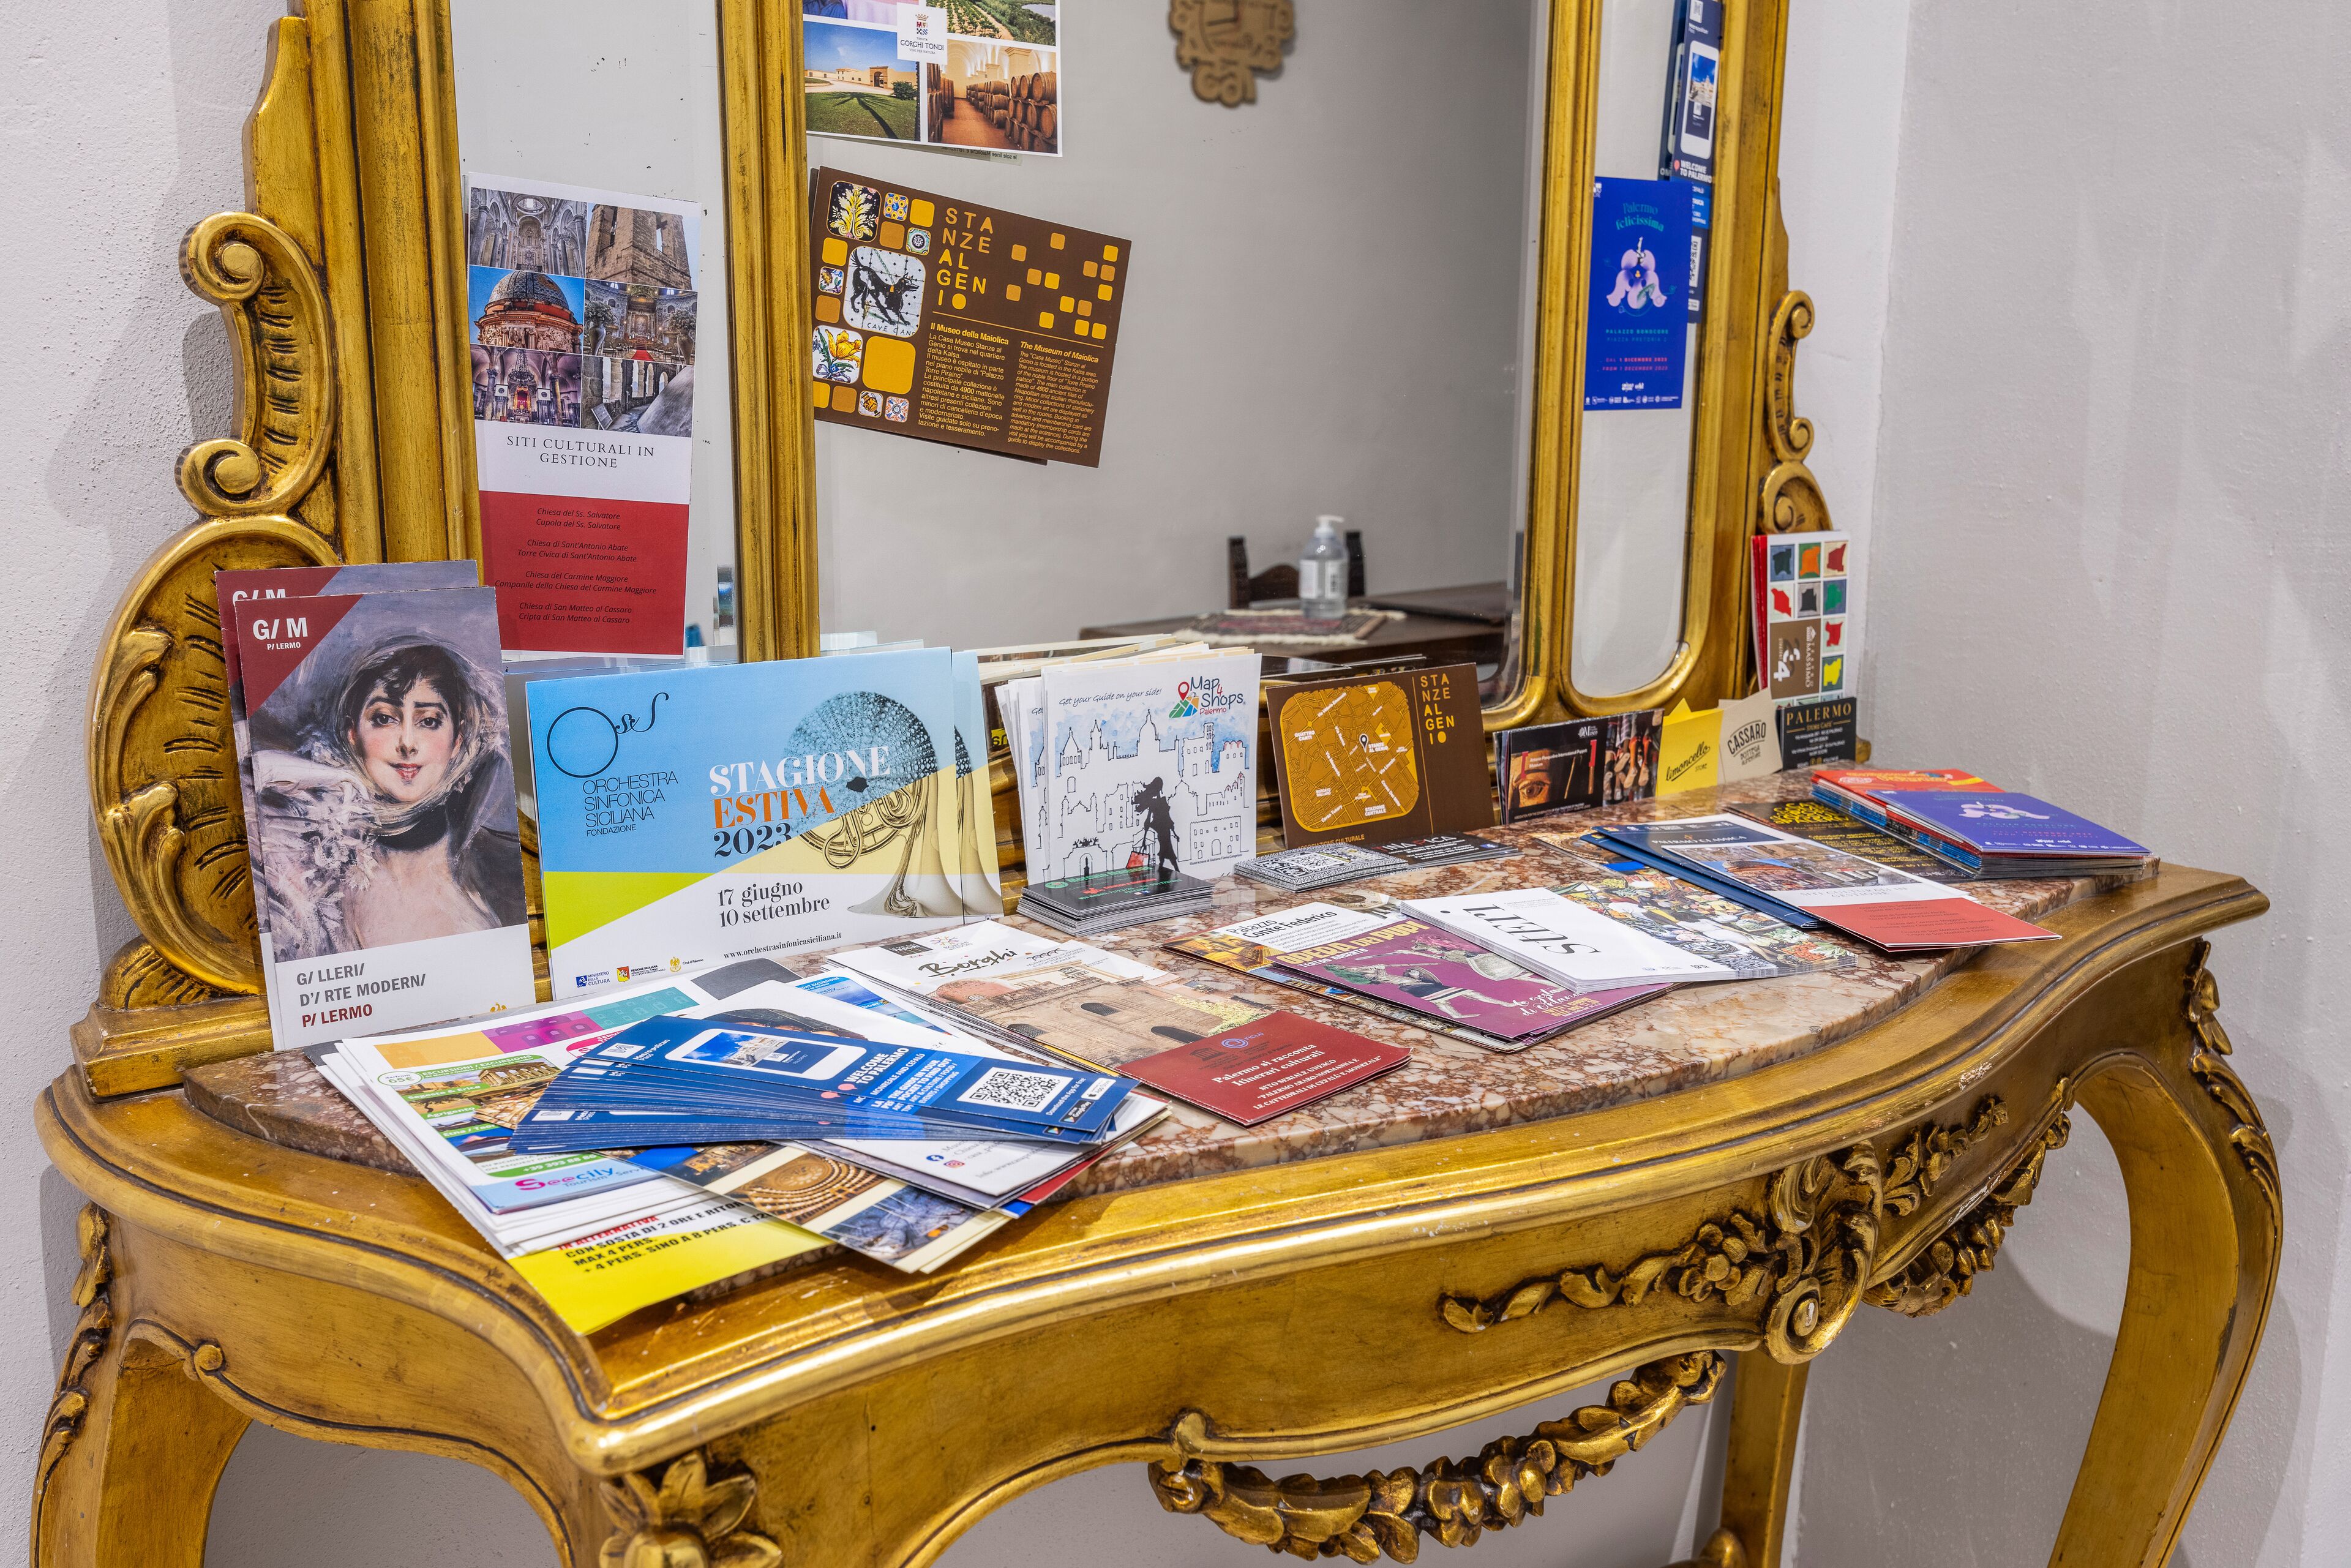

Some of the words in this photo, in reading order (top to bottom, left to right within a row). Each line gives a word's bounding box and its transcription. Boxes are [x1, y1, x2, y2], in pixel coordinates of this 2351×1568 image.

[1680, 168, 1687, 176] TO
[1689, 170, 1712, 183] PALERMO
[1681, 160, 1707, 174] WELCOME
[1623, 202, 1658, 214] Palermo
[945, 208, 993, 234] STA
[1616, 215, 1664, 231] felicissima
[942, 228, 991, 253] NZE
[939, 249, 969, 270] AL
[937, 269, 986, 294] GEN
[867, 323, 888, 332] CAVE
[937, 324, 961, 335] Museo
[962, 329, 979, 339] della
[980, 333, 1008, 345] Maiolica
[1021, 341, 1033, 350] The
[1034, 344, 1062, 356] Museum
[1072, 352, 1098, 363] Maiolica
[507, 436, 536, 448] SITI
[543, 438, 631, 455] CULTURALI
[639, 447, 654, 457] IN
[540, 453, 617, 468] GESTIONE
[588, 511, 620, 520] Salvatore
[519, 613, 541, 621] Cripta
[1805, 642, 1816, 688] MASSIMO
[1190, 676, 1220, 697] Map
[1420, 674, 1449, 688] STA
[1074, 696, 1091, 707] your
[1093, 693, 1114, 702] Guide
[1127, 691, 1143, 702] your
[1201, 692, 1243, 709] Shops
[1422, 687, 1451, 702] NZE
[1200, 707, 1227, 715] Palermo
[1424, 703, 1442, 716] AL
[1787, 702, 1851, 726] PALERMO
[1426, 715, 1455, 730] GEN
[1727, 722, 1766, 754] CASSARO
[710, 746, 890, 796] STAGIONE
[1666, 741, 1711, 781] limoncello
[583, 771, 678, 794] ORCHESTRA
[584, 789, 665, 811] SINFONICA
[712, 785, 836, 830] ESTIVA
[586, 806, 654, 827] SICILIANA
[587, 824, 636, 836] FONDAZIONE
[714, 823, 792, 858] 2023
[1335, 835, 1365, 844] CULTURALE
[718, 889, 733, 906] 17
[742, 882, 803, 907] giugno
[720, 909, 738, 928] 10
[743, 898, 830, 924] settembre
[1226, 920, 1278, 934] Palazzo
[1243, 926, 1285, 938] Conte
[1281, 912, 1337, 929] Federico
[724, 932, 841, 959] www.orchestrasinfonicasiciliana.it
[1276, 942, 1357, 964] OPERA
[1349, 933, 1385, 947] DEI
[1370, 921, 1430, 940] PUPI
[918, 948, 1018, 975] Borghi
[1297, 958, 1332, 967] TEATRO
[633, 1039, 670, 1060] Metropolitan
[422, 1065, 473, 1076] ESCURSIONI
[479, 1055, 531, 1068] EXCURSIONS
[844, 1053, 889, 1082] WELCOME
[872, 1048, 909, 1076] PALERMO
[1211, 1063, 1265, 1082] Palermo
[1273, 1043, 1317, 1063] racconta
[1231, 1068, 1281, 1086] Itinerari
[1281, 1050, 1325, 1070] culturali
[870, 1073, 899, 1095] MONREALE
[937, 1071, 959, 1089] SHOPPING
[1259, 1081, 1279, 1091] SITO
[1278, 1070, 1308, 1085] SERIALE
[1308, 1060, 1337, 1076] UNESCO
[1294, 1061, 1355, 1086] ARABO-NORMANNA
[408, 1091, 446, 1100] Segesta
[1263, 1086, 1308, 1106] CATTEDRALI
[427, 1106, 475, 1118] Agrigento
[564, 1176, 607, 1187] Tourism
[566, 1245, 596, 1258] CON
[598, 1231, 639, 1248] SOSTA
[669, 1216, 695, 1226] ORE
[576, 1215, 659, 1244] ALTERNATIVA
[574, 1253, 606, 1266] MAX
[617, 1238, 658, 1252] PERS.
